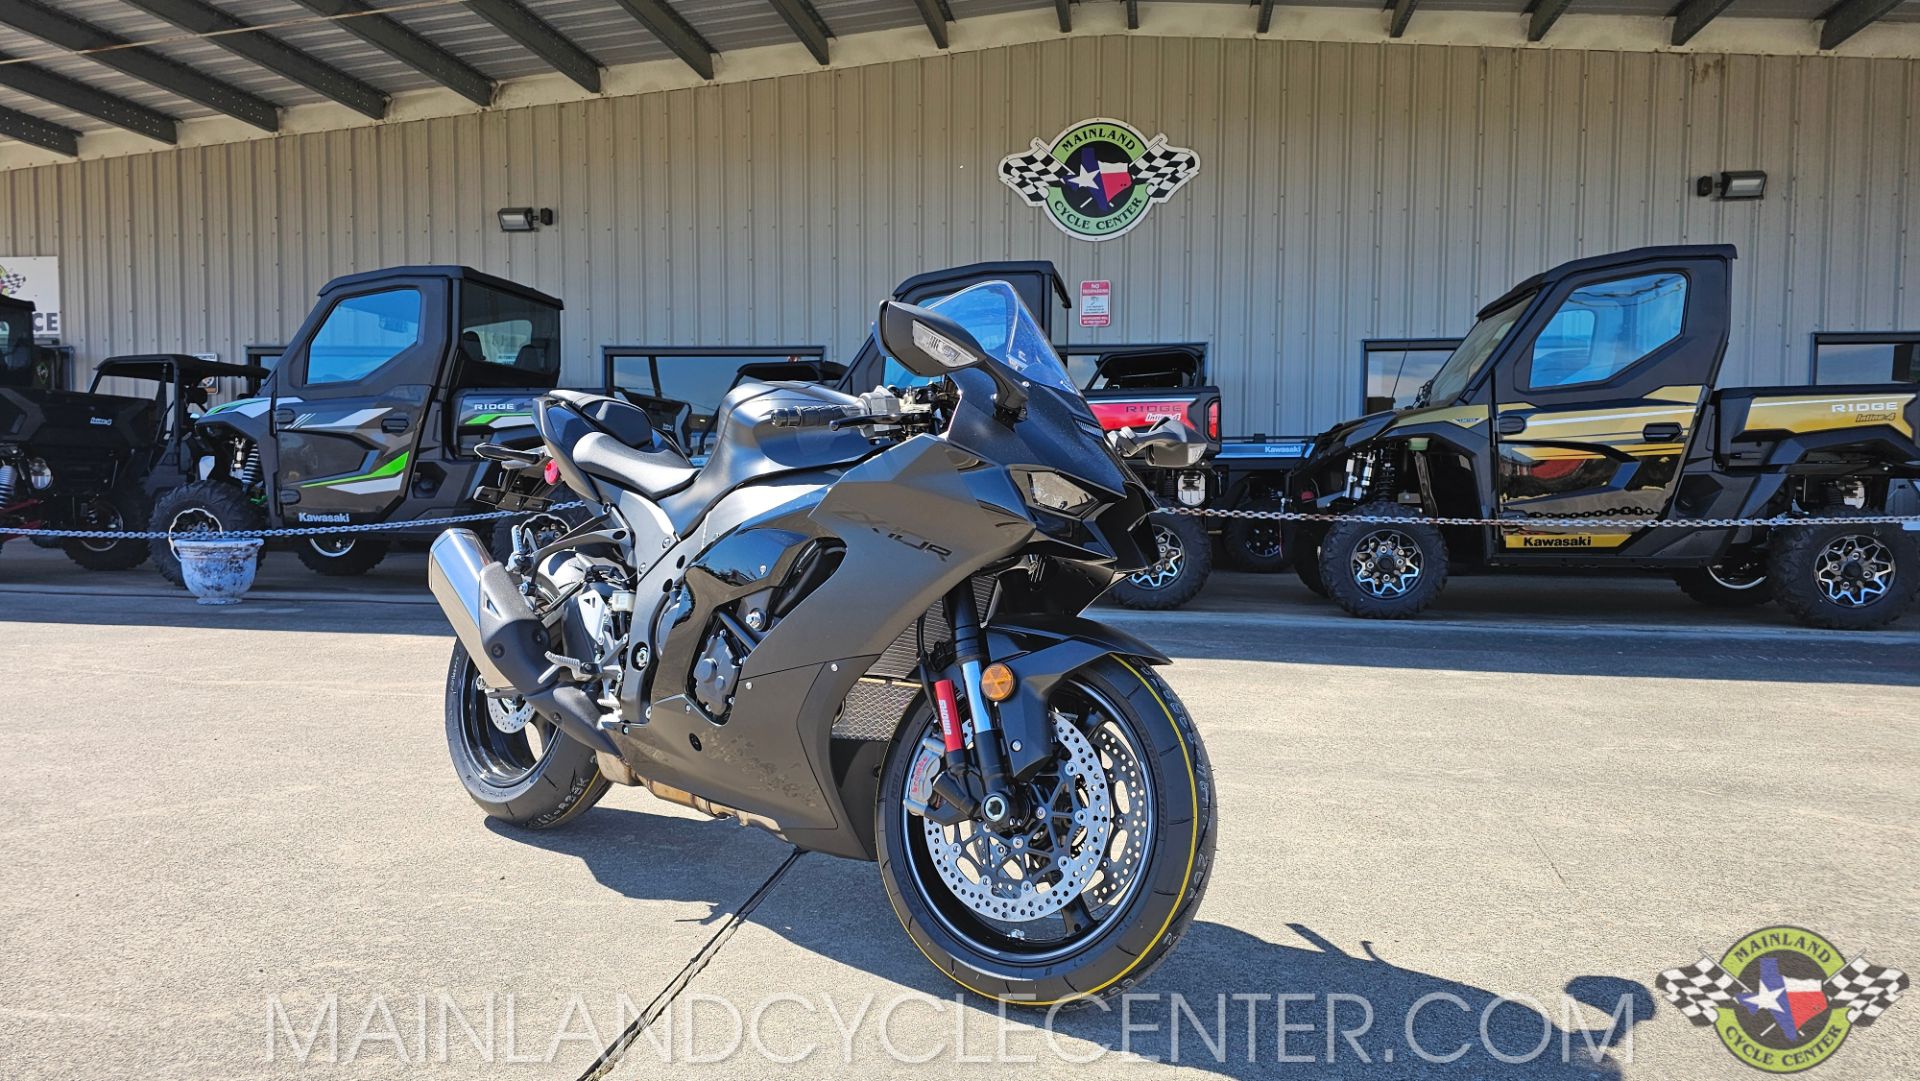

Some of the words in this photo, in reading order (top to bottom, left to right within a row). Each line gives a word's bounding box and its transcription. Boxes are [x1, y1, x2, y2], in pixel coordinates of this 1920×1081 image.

[1062, 128, 1136, 153] MAINLAND
[1054, 200, 1091, 230] CYCLE
[1096, 196, 1143, 231] CENTER
[32, 312, 58, 332] CE
[1126, 405, 1182, 413] RIDGE
[1831, 402, 1899, 413] RIDGE
[1855, 412, 1896, 423] Inline-4
[298, 512, 350, 523] Kawasaki
[1523, 535, 1592, 547] Kawasaki
